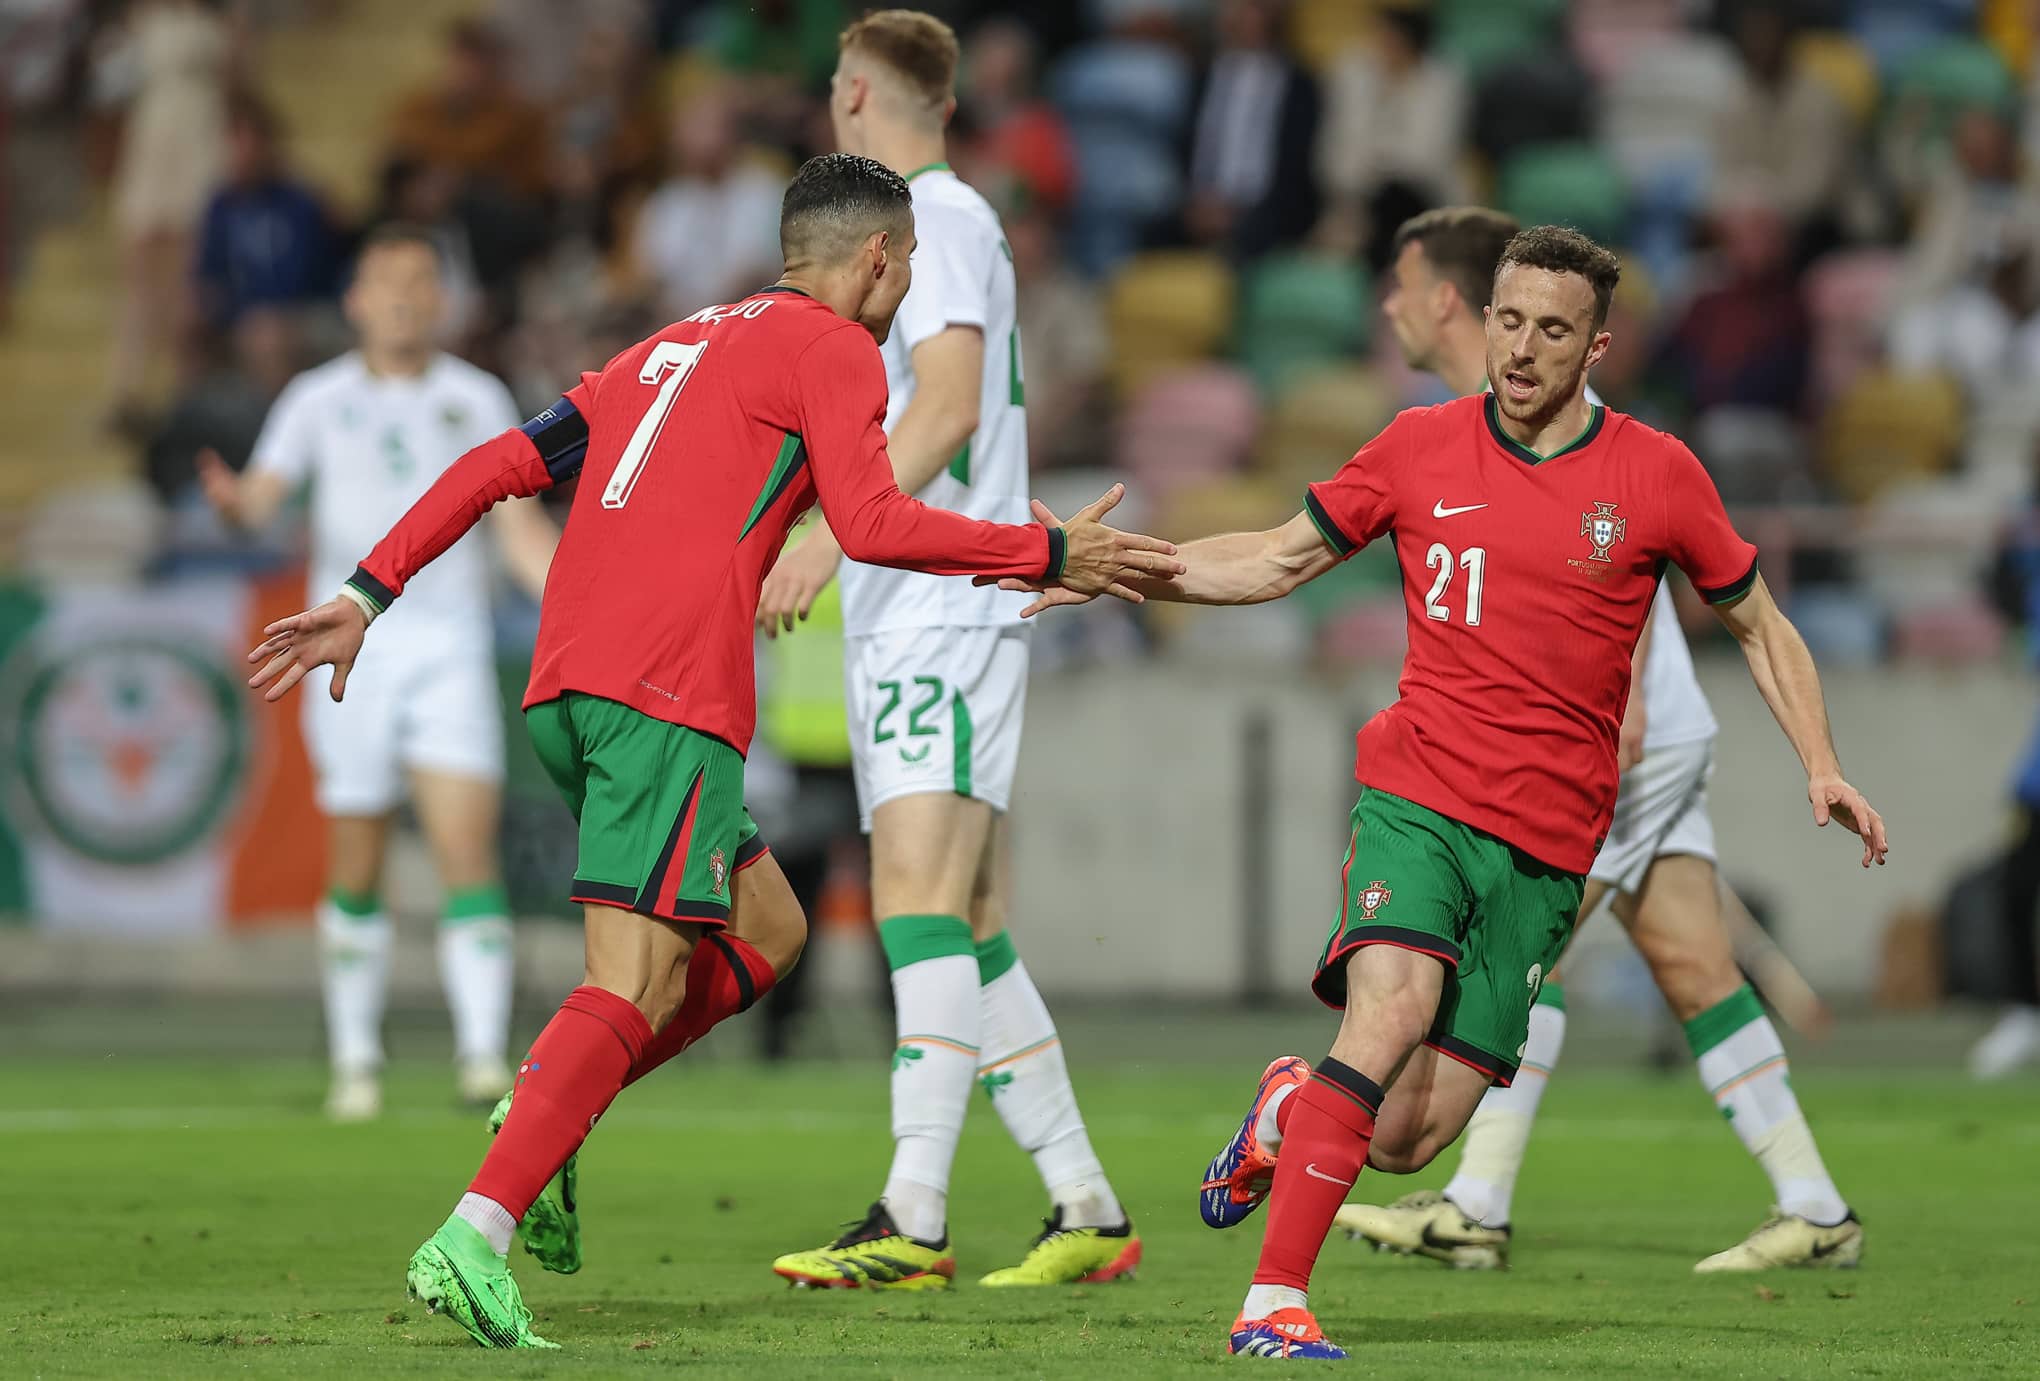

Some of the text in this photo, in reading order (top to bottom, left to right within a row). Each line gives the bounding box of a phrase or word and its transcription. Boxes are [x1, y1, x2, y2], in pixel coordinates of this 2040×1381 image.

[600, 339, 710, 510] 7
[1424, 542, 1486, 626] 21
[874, 676, 943, 743] 22
